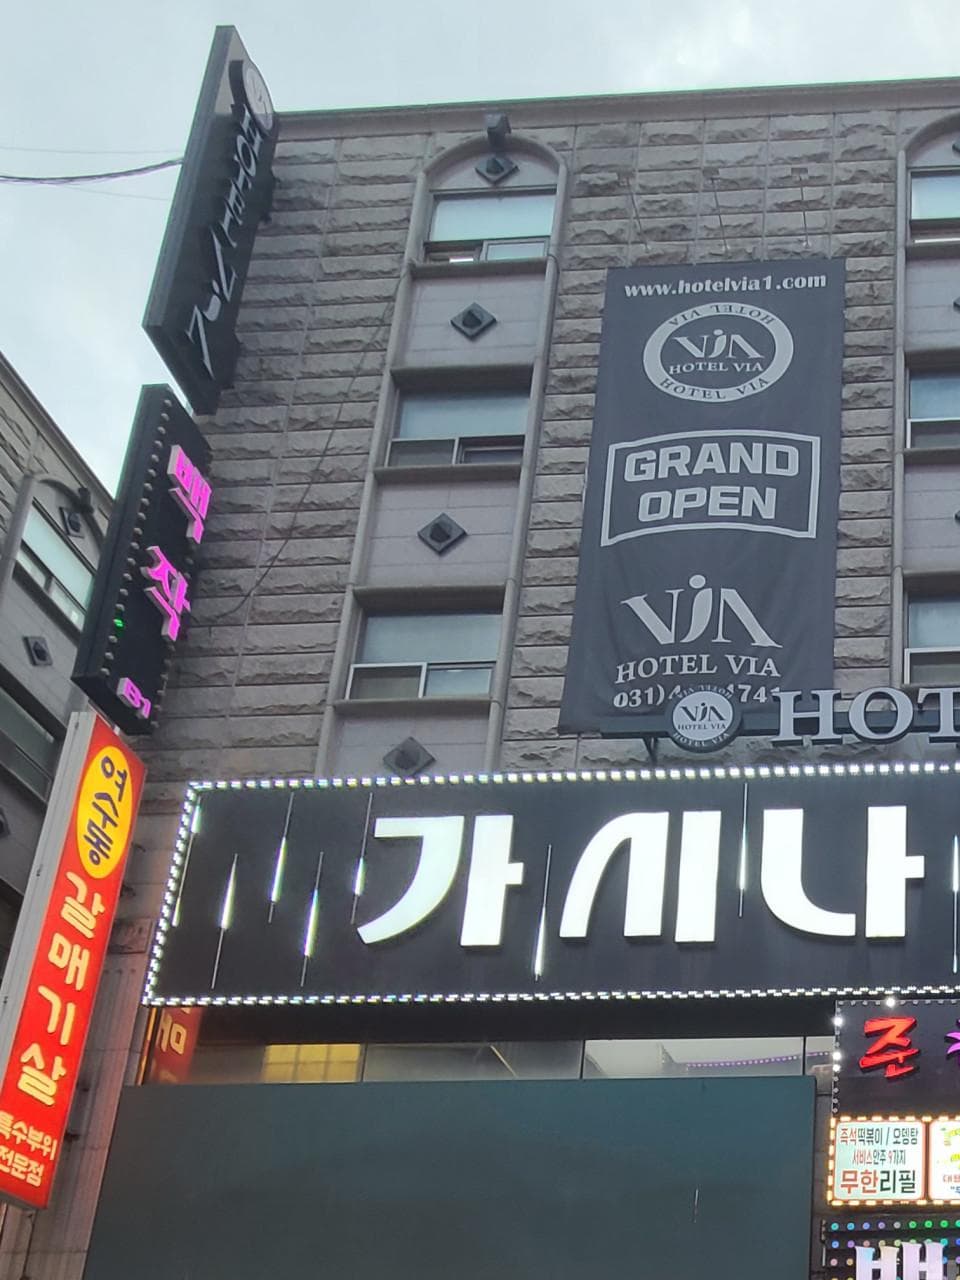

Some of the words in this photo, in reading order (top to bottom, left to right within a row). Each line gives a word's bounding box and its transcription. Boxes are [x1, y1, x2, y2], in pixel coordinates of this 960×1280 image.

[625, 275, 827, 297] www.hotelvia1.com
[669, 362, 728, 375] HOTEL
[734, 362, 764, 372] VIA
[660, 378, 725, 399] HOTEL
[736, 378, 769, 396] VIA
[624, 442, 799, 482] GRAND
[638, 486, 776, 522] OPEN
[615, 654, 718, 684] HOTEL
[725, 653, 781, 678] VIA
[678, 723, 708, 731] HOTEL
[84, 756, 128, 866] 여수동
[20, 870, 106, 1107] 갈매기살
[0, 1110, 58, 1160] 특수부위
[893, 1127, 919, 1146] 오뎅탕
[0, 1145, 45, 1187] 전문점
[853, 1149, 886, 1166] 서비스안주
[840, 1169, 917, 1195] 무한리필
